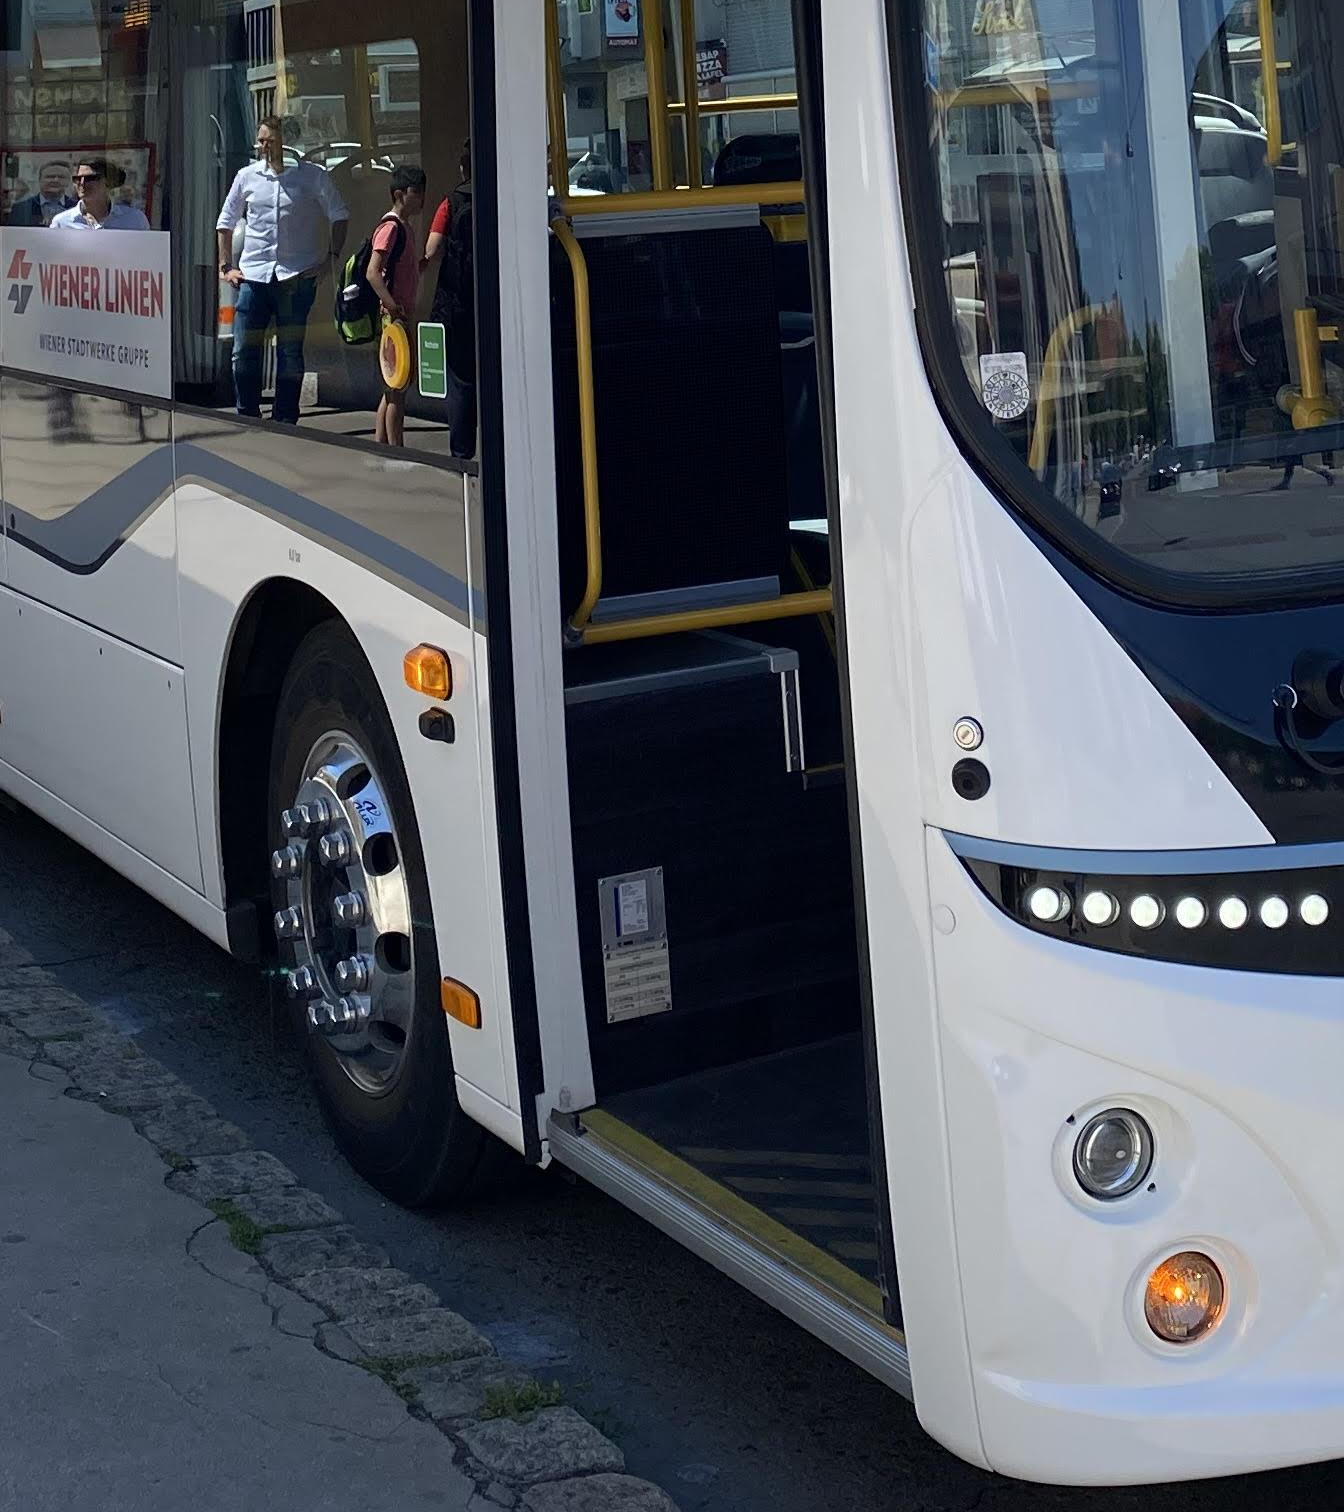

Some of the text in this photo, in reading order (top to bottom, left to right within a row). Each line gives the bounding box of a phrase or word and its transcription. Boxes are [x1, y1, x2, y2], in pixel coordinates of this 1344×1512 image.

[39, 262, 164, 319] WIENER LINIEN
[39, 334, 149, 368] WIENER STADTWERKE GRUPPE
